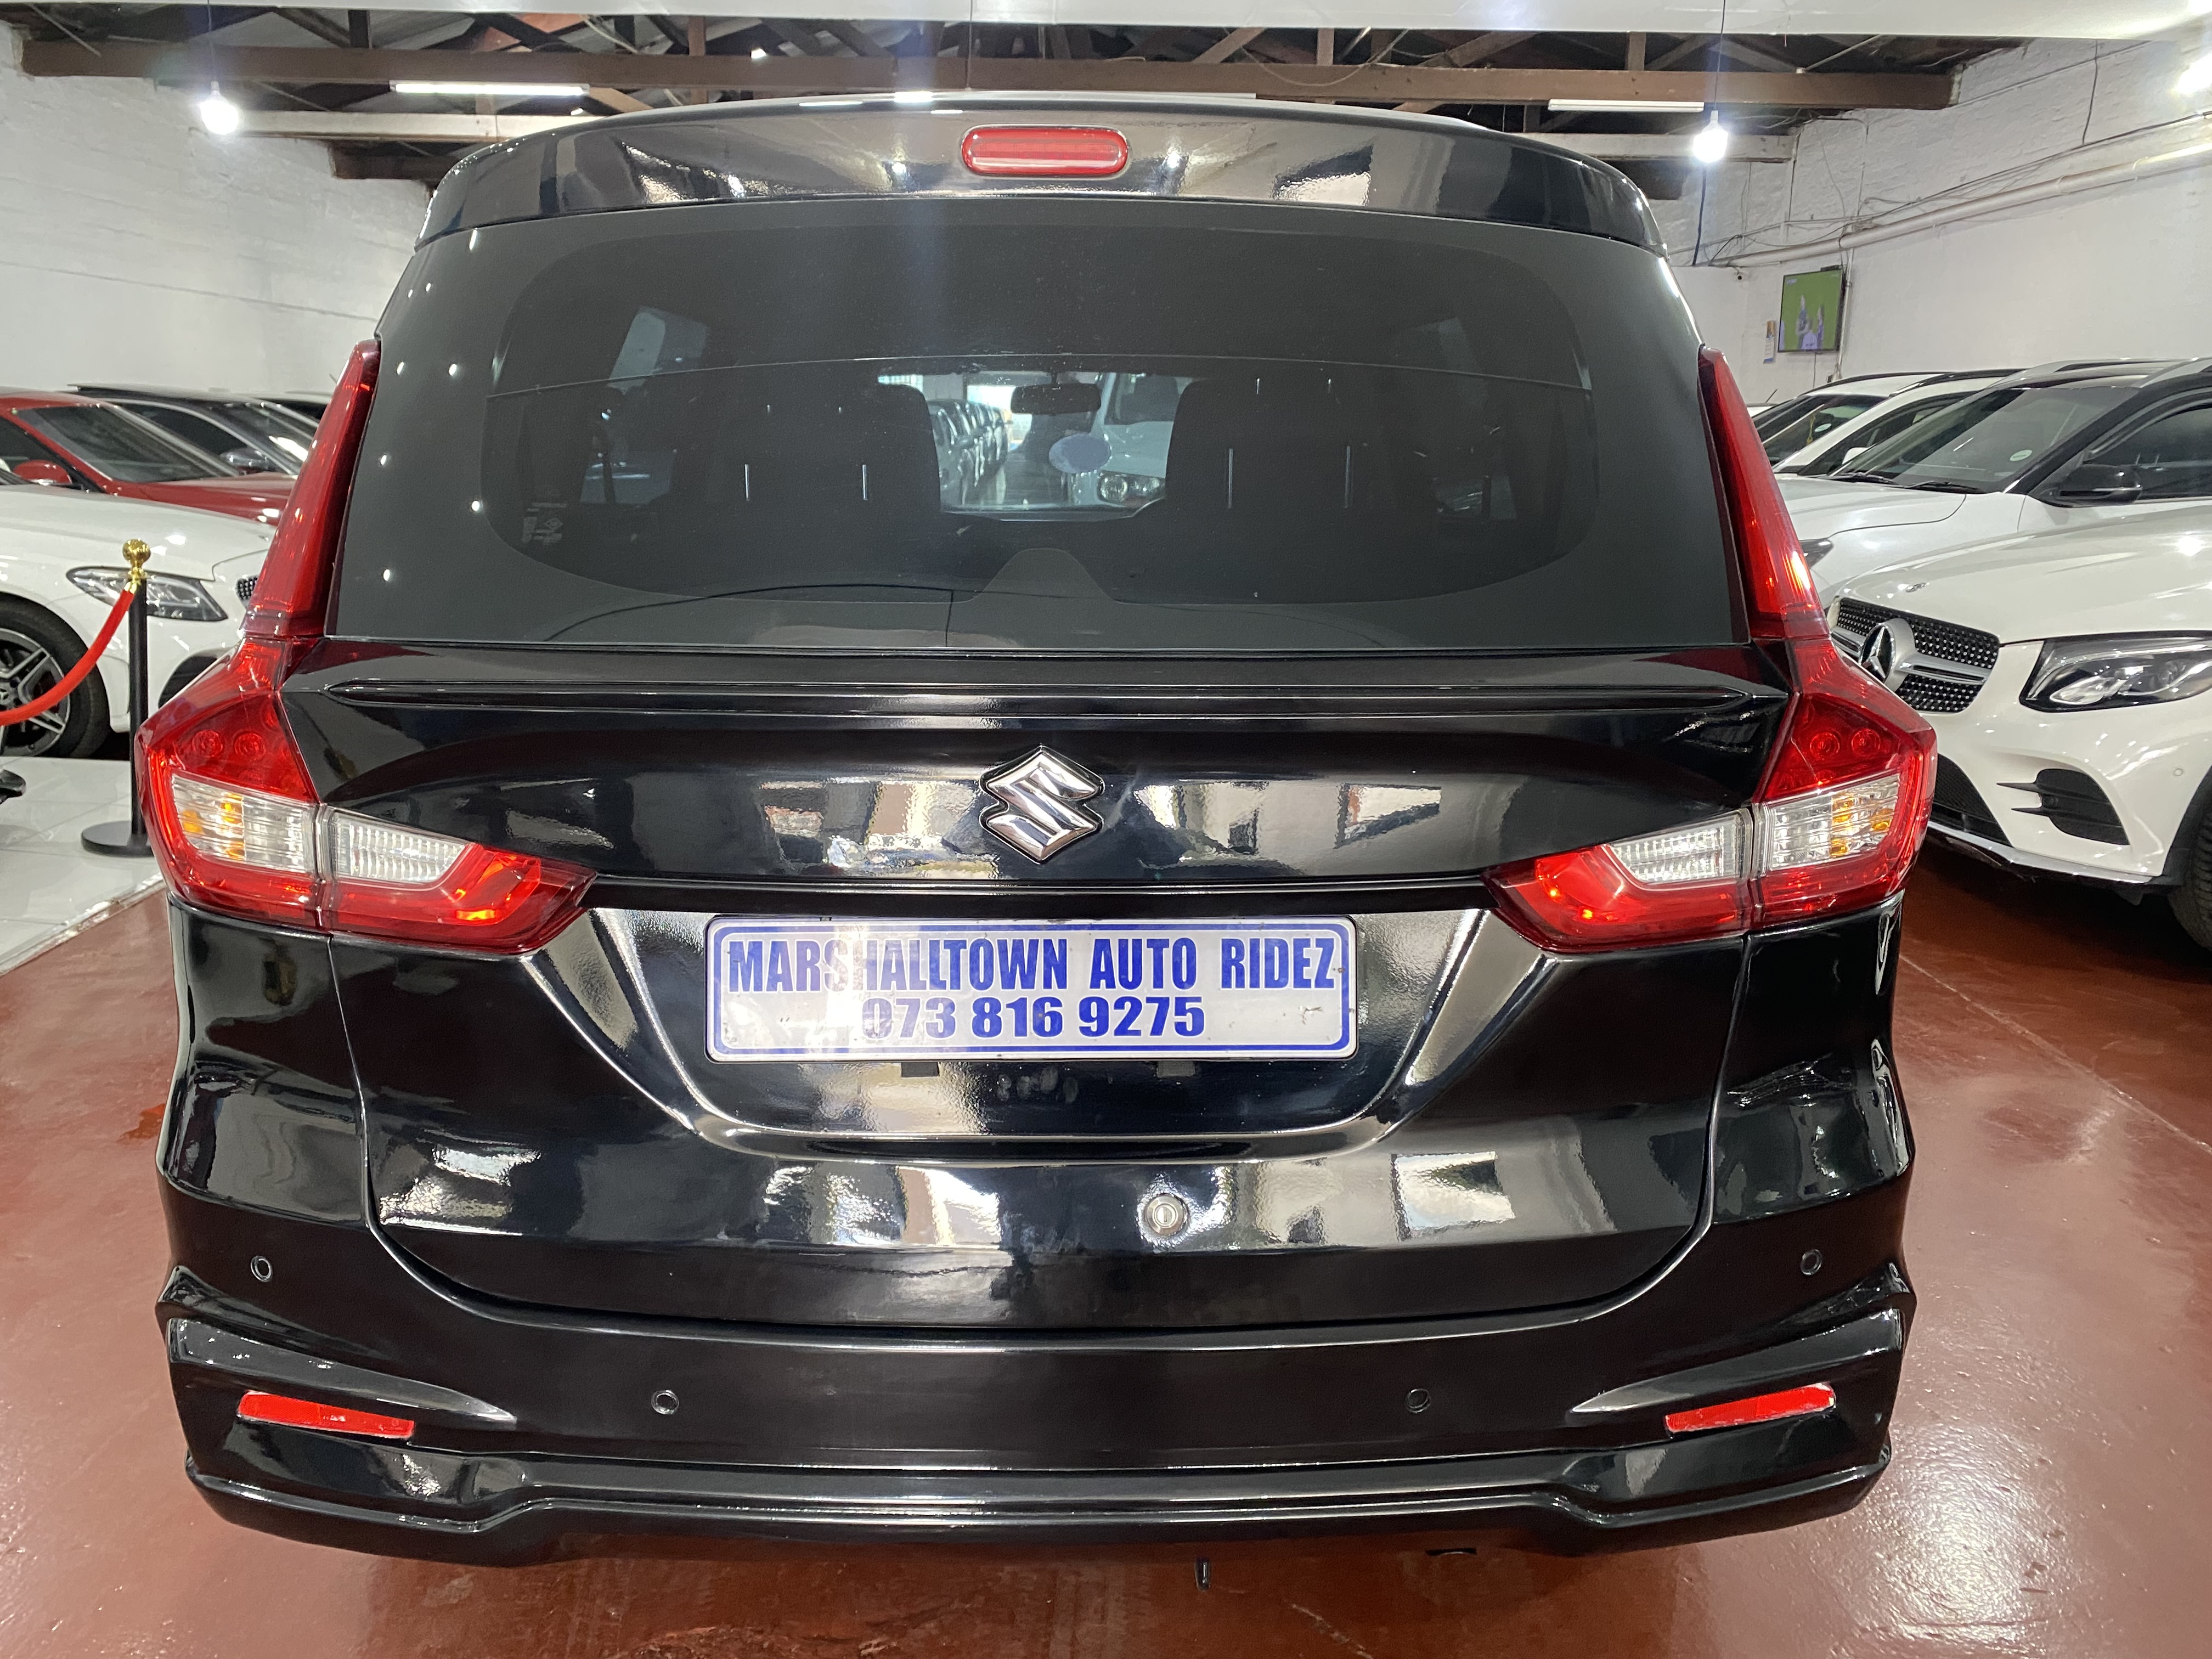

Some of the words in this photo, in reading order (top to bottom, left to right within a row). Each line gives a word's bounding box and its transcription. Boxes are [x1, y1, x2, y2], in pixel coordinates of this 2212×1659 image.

[728, 937, 1068, 992] MARSHALLTOWN
[1089, 937, 1198, 991] AUTO
[1221, 937, 1335, 990] RIDEZ
[862, 997, 956, 1039] 073
[972, 996, 1063, 1039] 816
[1078, 995, 1205, 1038] 9275
